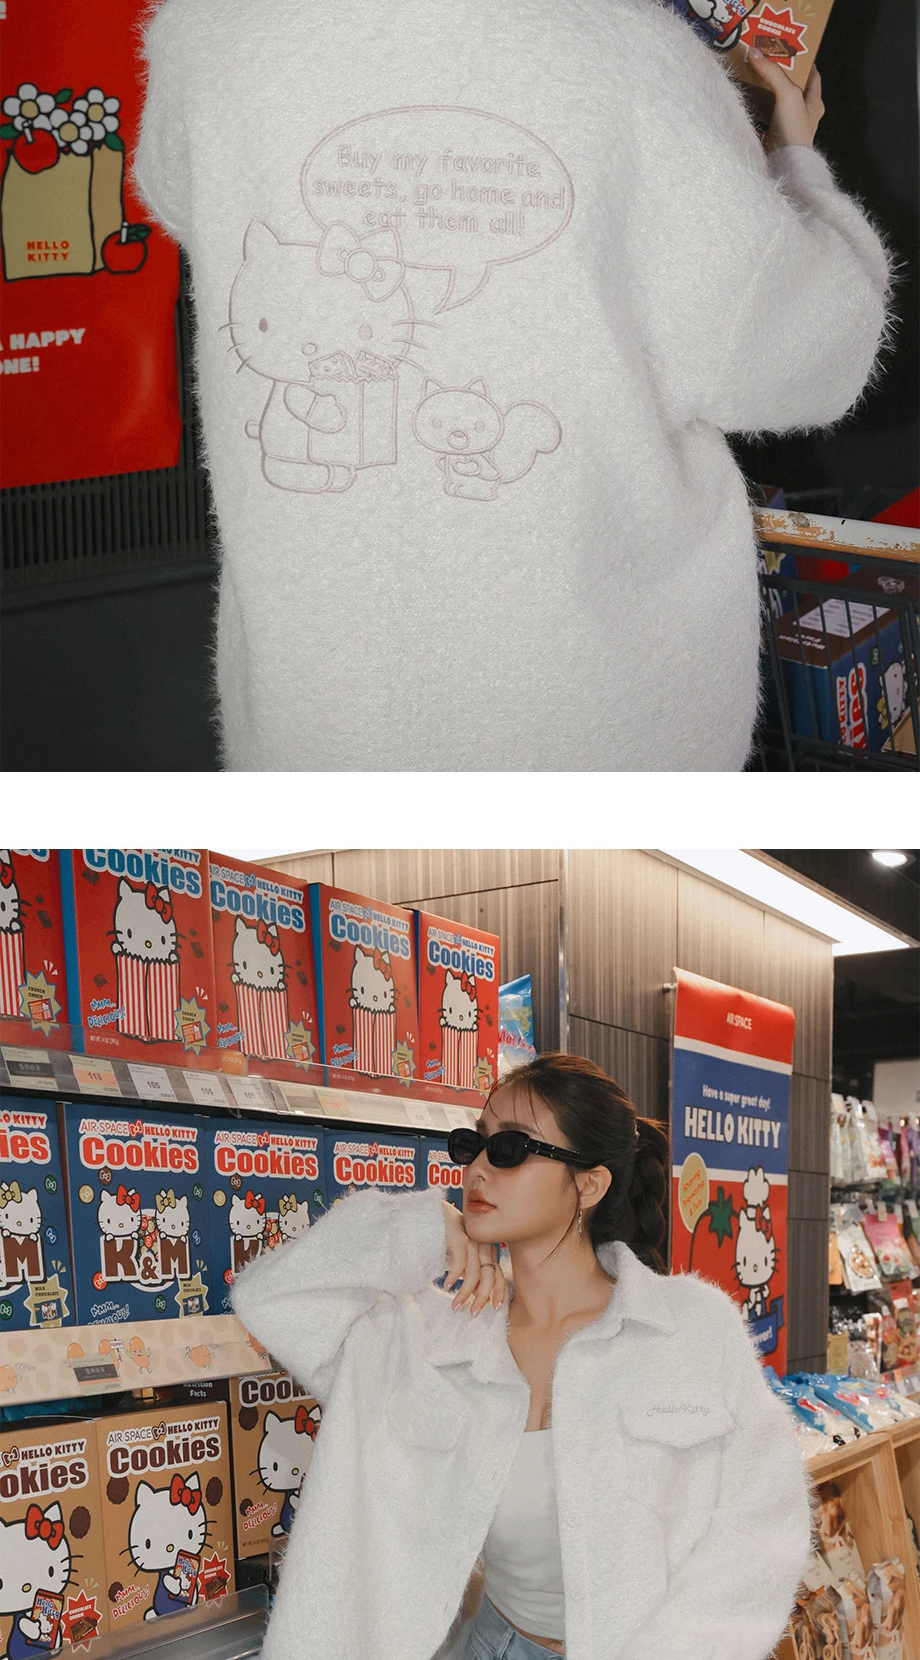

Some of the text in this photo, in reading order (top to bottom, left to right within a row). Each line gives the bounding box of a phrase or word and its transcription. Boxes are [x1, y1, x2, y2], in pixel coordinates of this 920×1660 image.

[337, 144, 542, 178] Buy my favorite
[312, 177, 566, 210] sweets, go home and
[362, 206, 526, 236] eat them all!
[26, 239, 70, 251] HELLO
[27, 251, 70, 262] KITTY
[10, 328, 86, 351] HAPPY
[85, 849, 201, 895] Cookies
[210, 880, 305, 930] Cookies
[281, 886, 303, 902] KITTY
[703, 1084, 771, 1112] Have super great day!
[80, 1122, 197, 1139] AIR SPACE HELLO KITTY
[684, 1105, 781, 1149] HELLO KITTY
[82, 1136, 198, 1171] Cookies
[217, 1147, 318, 1177] Cookies
[168, 1418, 220, 1435] HELLO KITTY
[110, 1436, 221, 1475] Cookies
